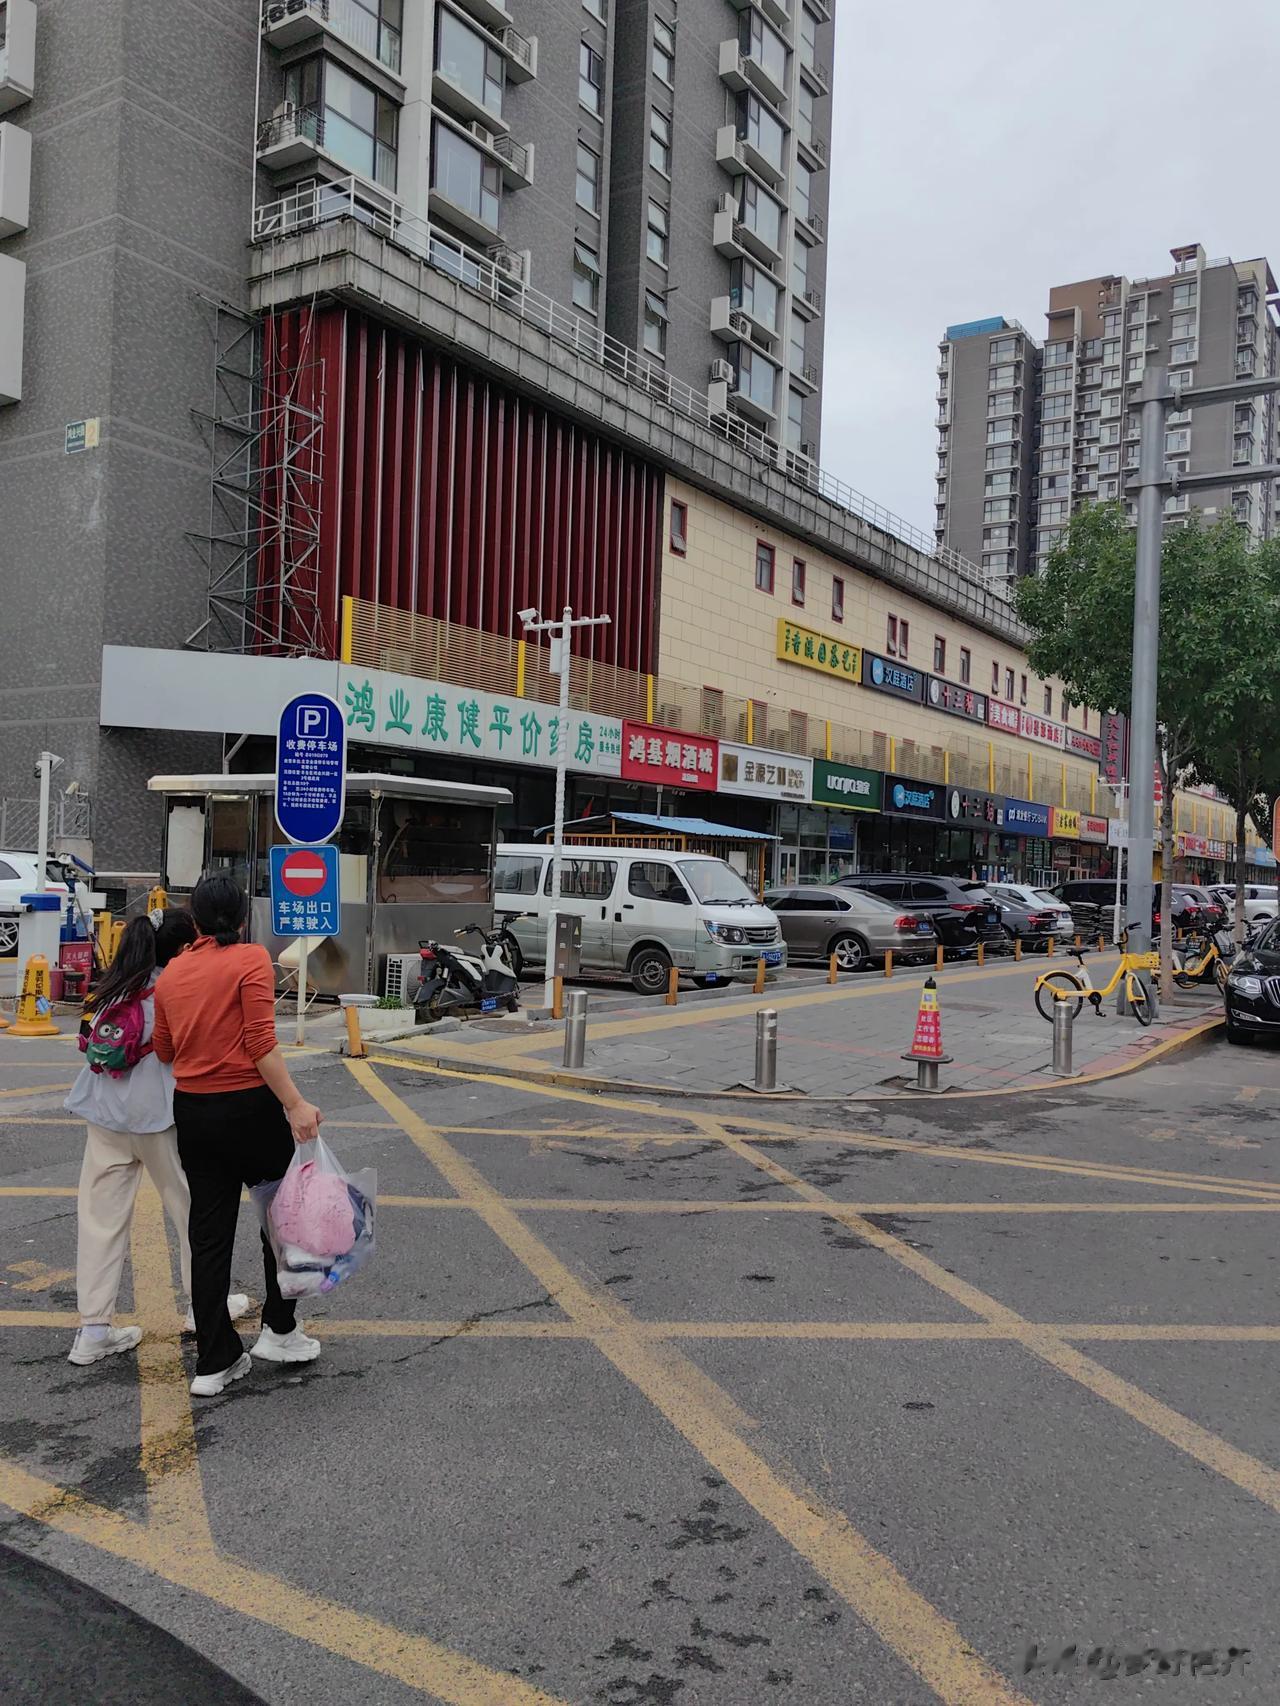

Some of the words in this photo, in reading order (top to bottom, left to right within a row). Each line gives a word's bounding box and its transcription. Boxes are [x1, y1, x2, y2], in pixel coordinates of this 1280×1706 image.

[886, 667, 914, 692] 汉庭酒店
[304, 710, 321, 733] P
[345, 679, 595, 763] 鸿业康健平价药房
[286, 739, 338, 752] 收费停车场
[628, 734, 713, 774] 鸿基烟酒城
[278, 900, 331, 914] 车场出口
[279, 916, 332, 931] 严禁驶入
